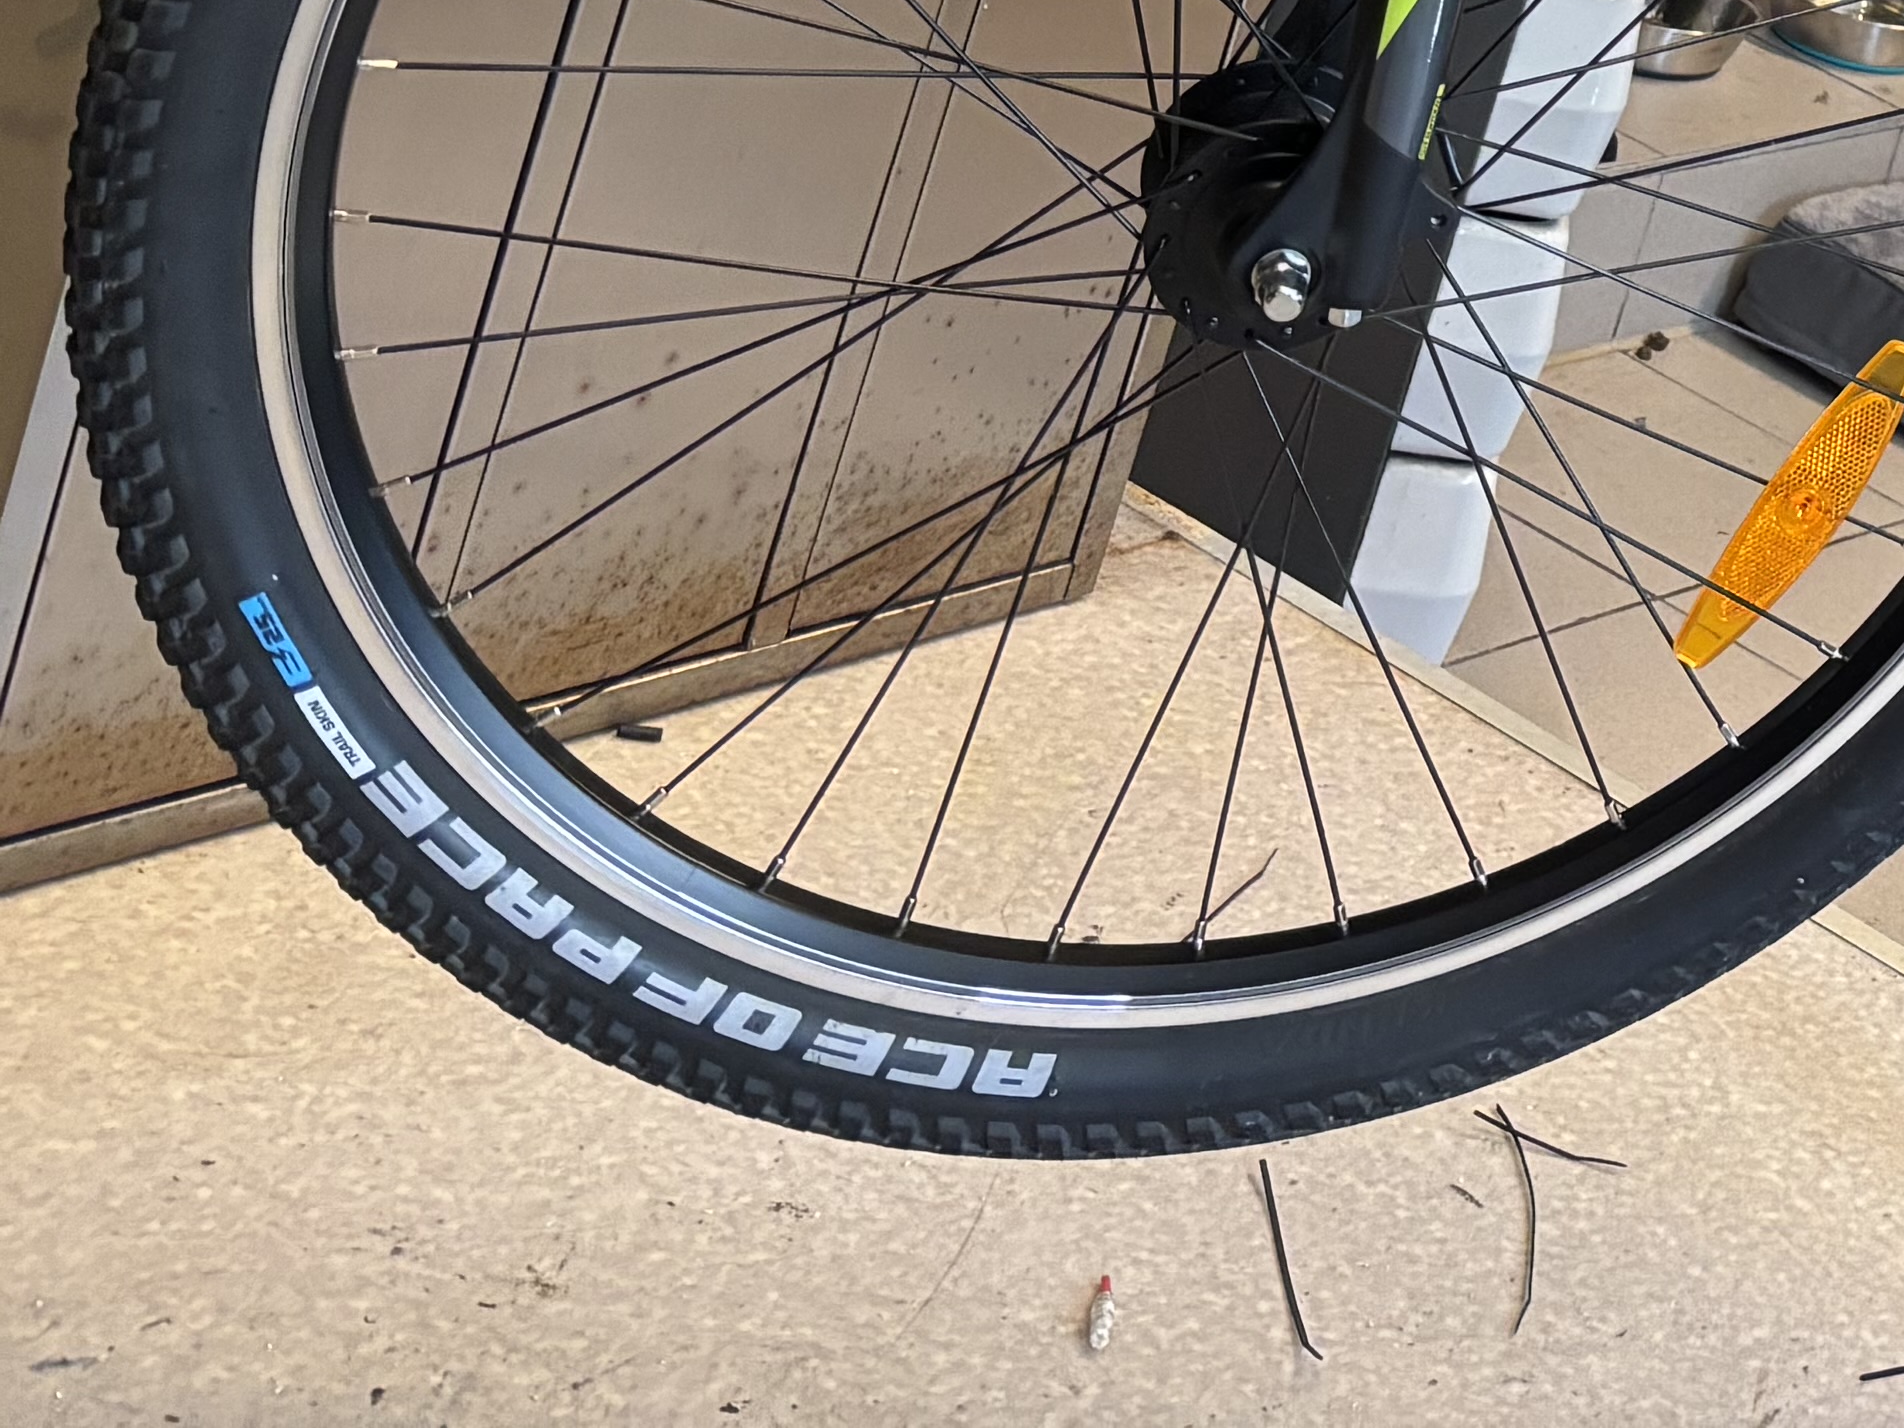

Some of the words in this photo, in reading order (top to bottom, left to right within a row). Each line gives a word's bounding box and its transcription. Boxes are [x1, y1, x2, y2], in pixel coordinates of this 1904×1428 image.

[306, 699, 336, 733] SKIN
[331, 730, 362, 768] TRAIL
[360, 759, 643, 985] PACE
[632, 976, 802, 1053] OF
[802, 1018, 1058, 1099] ACE
